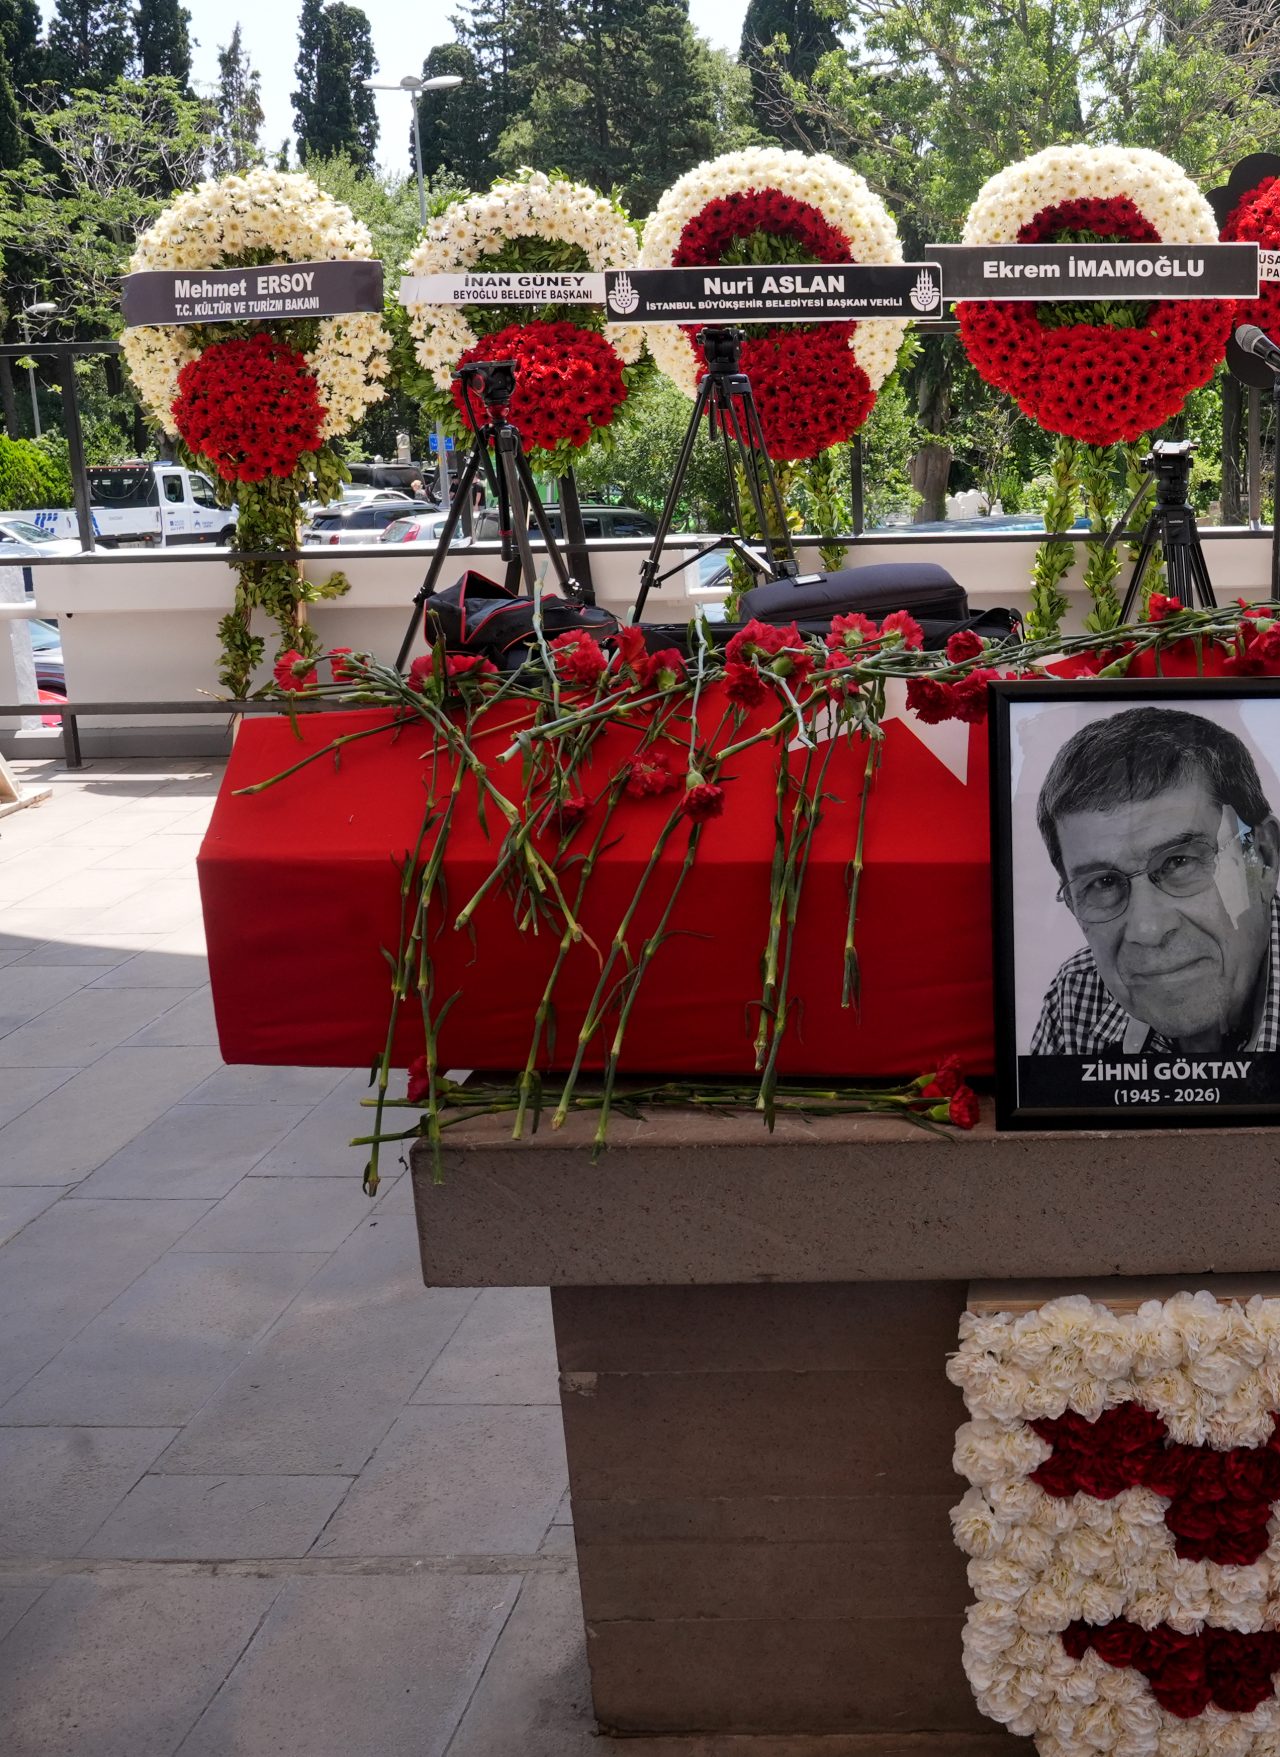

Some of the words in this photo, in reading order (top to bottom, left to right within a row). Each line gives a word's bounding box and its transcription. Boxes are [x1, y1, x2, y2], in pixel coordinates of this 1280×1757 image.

[983, 259, 1061, 279] Ekrem
[1068, 255, 1205, 278] İMAMOĞLU
[174, 278, 247, 299] Mehmet
[256, 272, 315, 295] ERSOY
[464, 275, 511, 287] İNAN
[517, 274, 586, 287] GÜNEY
[703, 275, 754, 296] Nuri
[761, 274, 846, 295] ASLAN
[453, 288, 500, 300] BEYOĞLU
[501, 288, 549, 300] BELEDİYE
[550, 289, 593, 302] BAŞKANI
[645, 300, 696, 311] İSTANBUL
[697, 298, 764, 311] BÜYÜKŞEHİR
[765, 297, 825, 308] BELEDİYESİ
[826, 298, 868, 309] BAŞKAN
[869, 295, 904, 308] VEKİLİ
[175, 303, 192, 317] T.C.
[194, 300, 232, 316] KÜLTÜR
[233, 302, 246, 314] VE
[248, 297, 283, 313] TURİZM
[285, 296, 320, 311] BAKANI
[1081, 1058, 1149, 1083] ZİHNİ
[1153, 1057, 1253, 1081] GÖKTAY
[1113, 1088, 1161, 1105] (1945
[1174, 1087, 1220, 1104] 2026)
